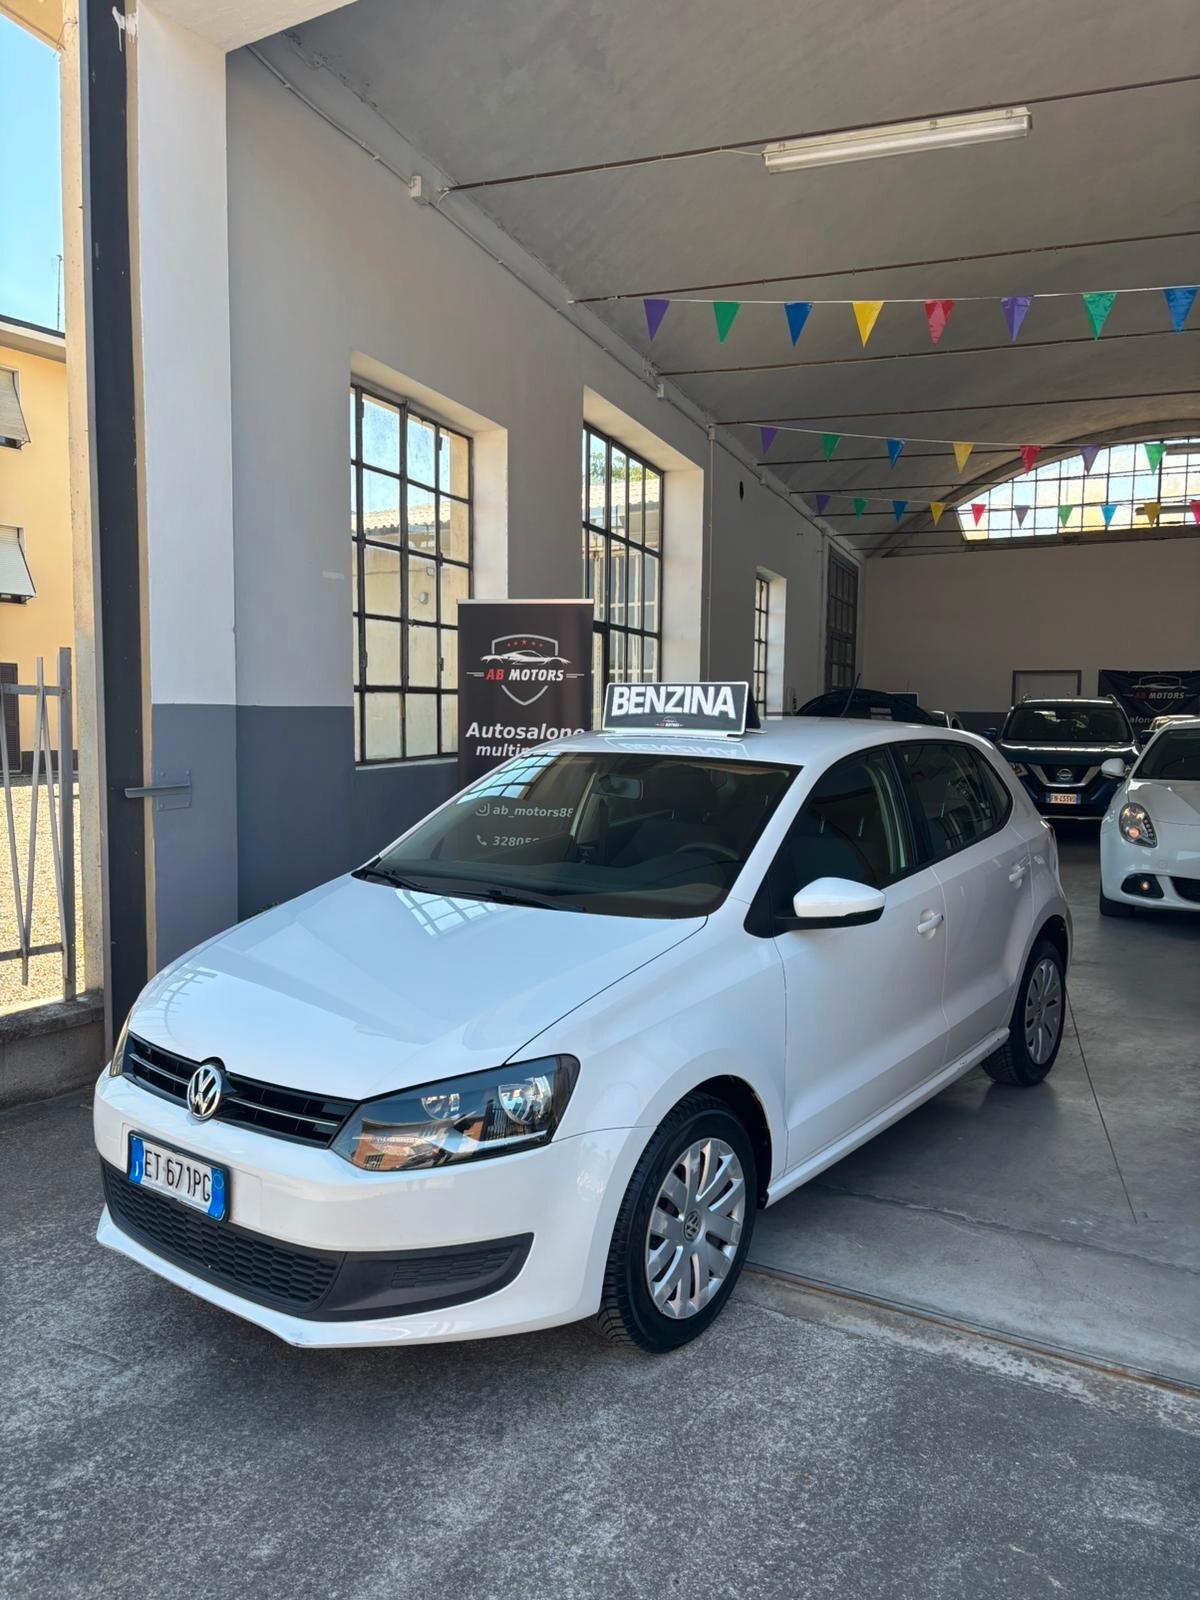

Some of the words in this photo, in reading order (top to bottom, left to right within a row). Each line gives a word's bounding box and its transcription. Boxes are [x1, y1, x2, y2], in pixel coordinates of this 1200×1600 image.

[486, 669, 505, 681] AB
[508, 669, 564, 681] MOTORS
[611, 686, 737, 720] BENZINA
[1149, 692, 1185, 700] MOTORS
[144, 1149, 161, 1181] ET
[166, 1158, 212, 1202] 671PG
